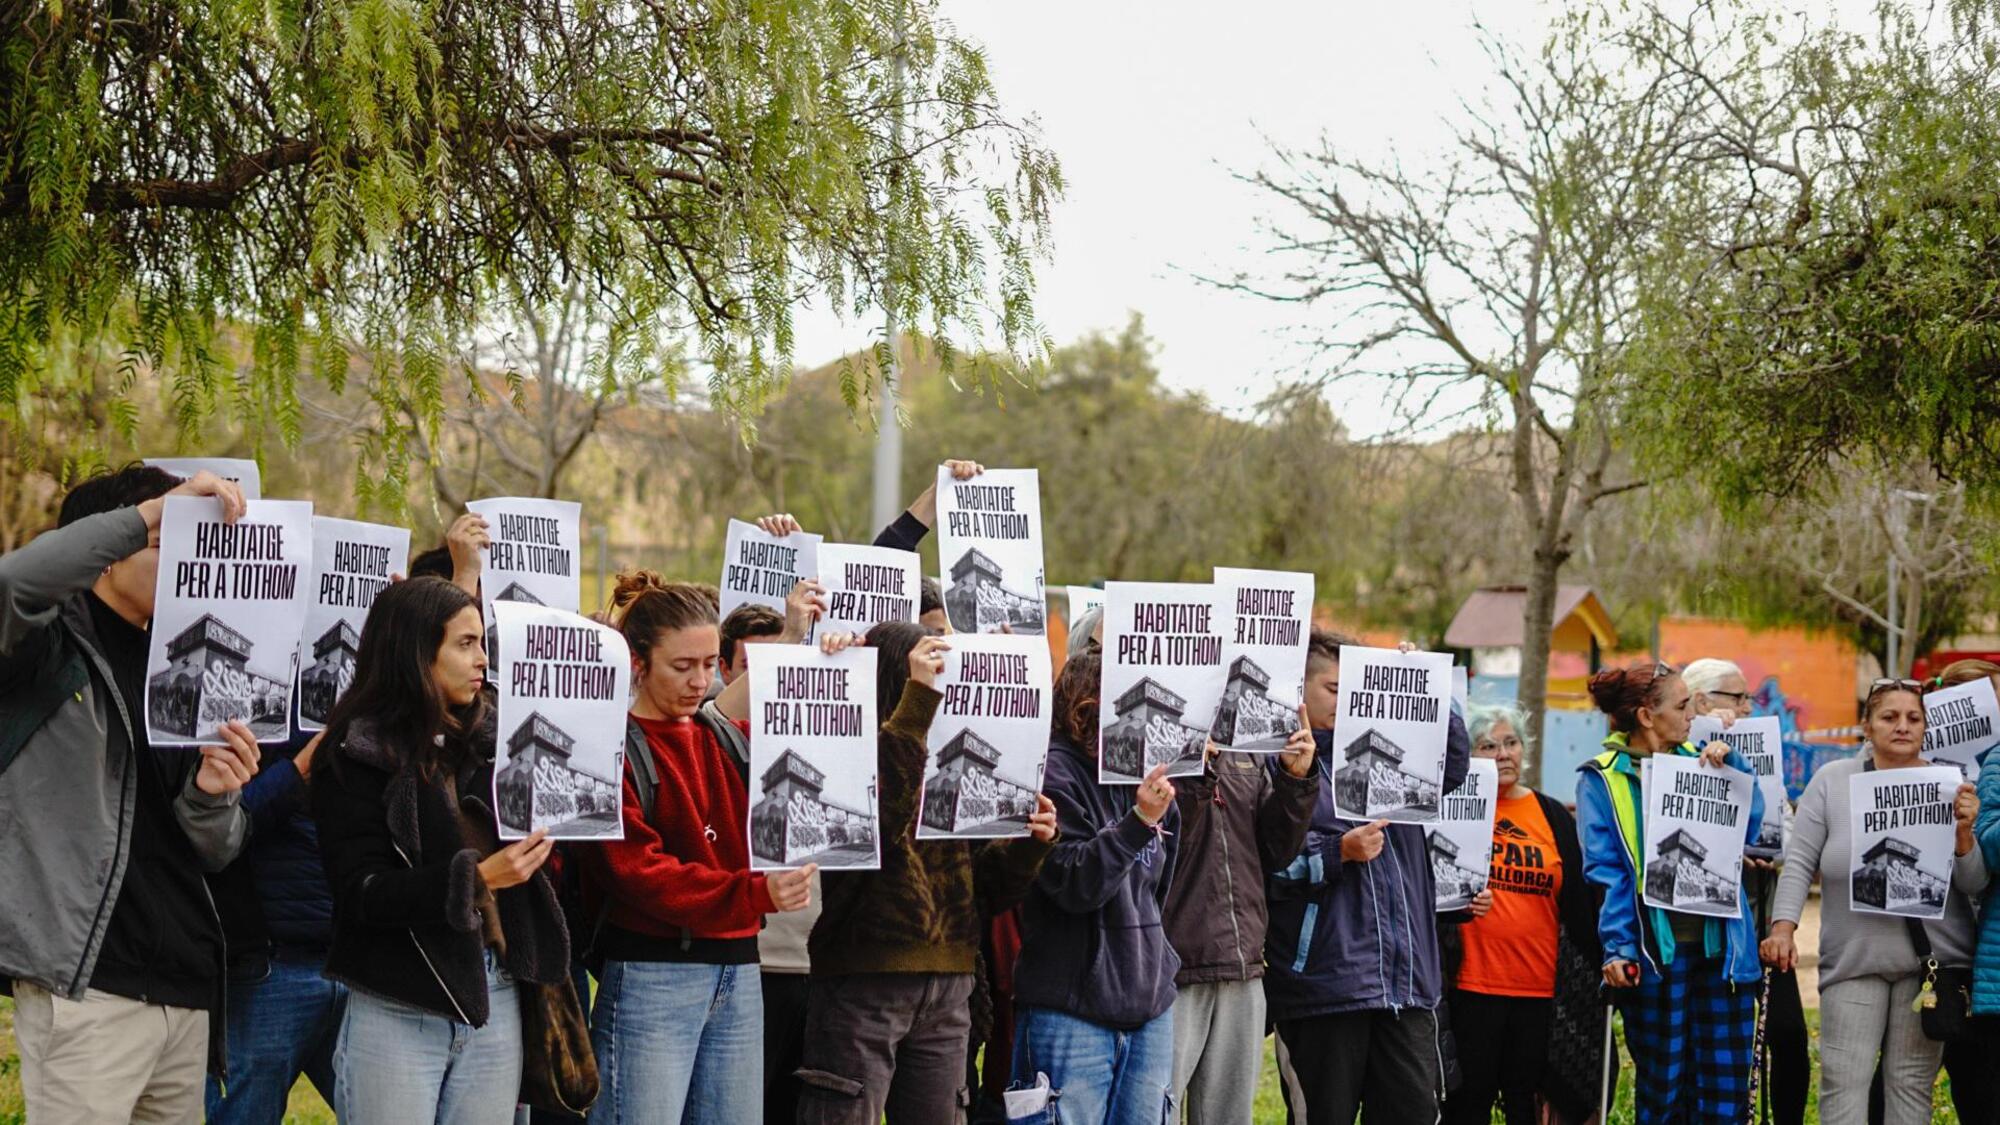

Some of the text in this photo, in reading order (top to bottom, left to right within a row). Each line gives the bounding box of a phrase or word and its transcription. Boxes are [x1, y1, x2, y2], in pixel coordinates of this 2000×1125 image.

[955, 485, 1016, 512] HABITATGE
[196, 522, 284, 561] HABITATGE
[499, 513, 561, 546] HABITATGE
[949, 512, 1030, 540] PER A TOTHOM
[334, 541, 391, 578] HABITATGE
[489, 542, 571, 577] PER A TOTHOM
[740, 540, 798, 573] HABITATGE
[175, 562, 297, 600] PER A TOTHOM
[319, 573, 345, 606] PER
[346, 576, 354, 607] A
[727, 565, 748, 591] PER
[750, 569, 759, 593] A
[845, 563, 905, 596] HABITATGE
[830, 592, 913, 624] PER A TOTHOM
[1134, 603, 1212, 633] HABITATGE
[1236, 587, 1295, 617] HABITATGE
[526, 624, 604, 663] HABITATGE
[1247, 617, 1255, 645] A
[1259, 618, 1300, 647] TOTHOM
[1118, 634, 1222, 666] PER A TOTHOM
[512, 662, 616, 700] PER A TOTHOM
[777, 666, 849, 701] HABITATGE
[960, 651, 1029, 685] HABITATGE
[1363, 664, 1429, 695] HABITATGE
[944, 684, 1040, 718] PER A TOTHOM
[1349, 691, 1439, 723] PER A TOTHOM
[1925, 696, 1979, 728] ABITATGE
[764, 702, 862, 737] PER A TOTHOM
[1936, 728, 1945, 749] A
[1944, 716, 1992, 747] TOTHOM
[1675, 771, 1732, 802] HABITATGE
[1874, 782, 1941, 810] HABITATGE
[1447, 798, 1487, 821] TOTHOM
[1661, 793, 1739, 828] PER A TOTHOM
[1864, 803, 1953, 833] PER A TOTHOM
[1491, 842, 1544, 869] PAH
[1488, 865, 1554, 890] ALLORCA
